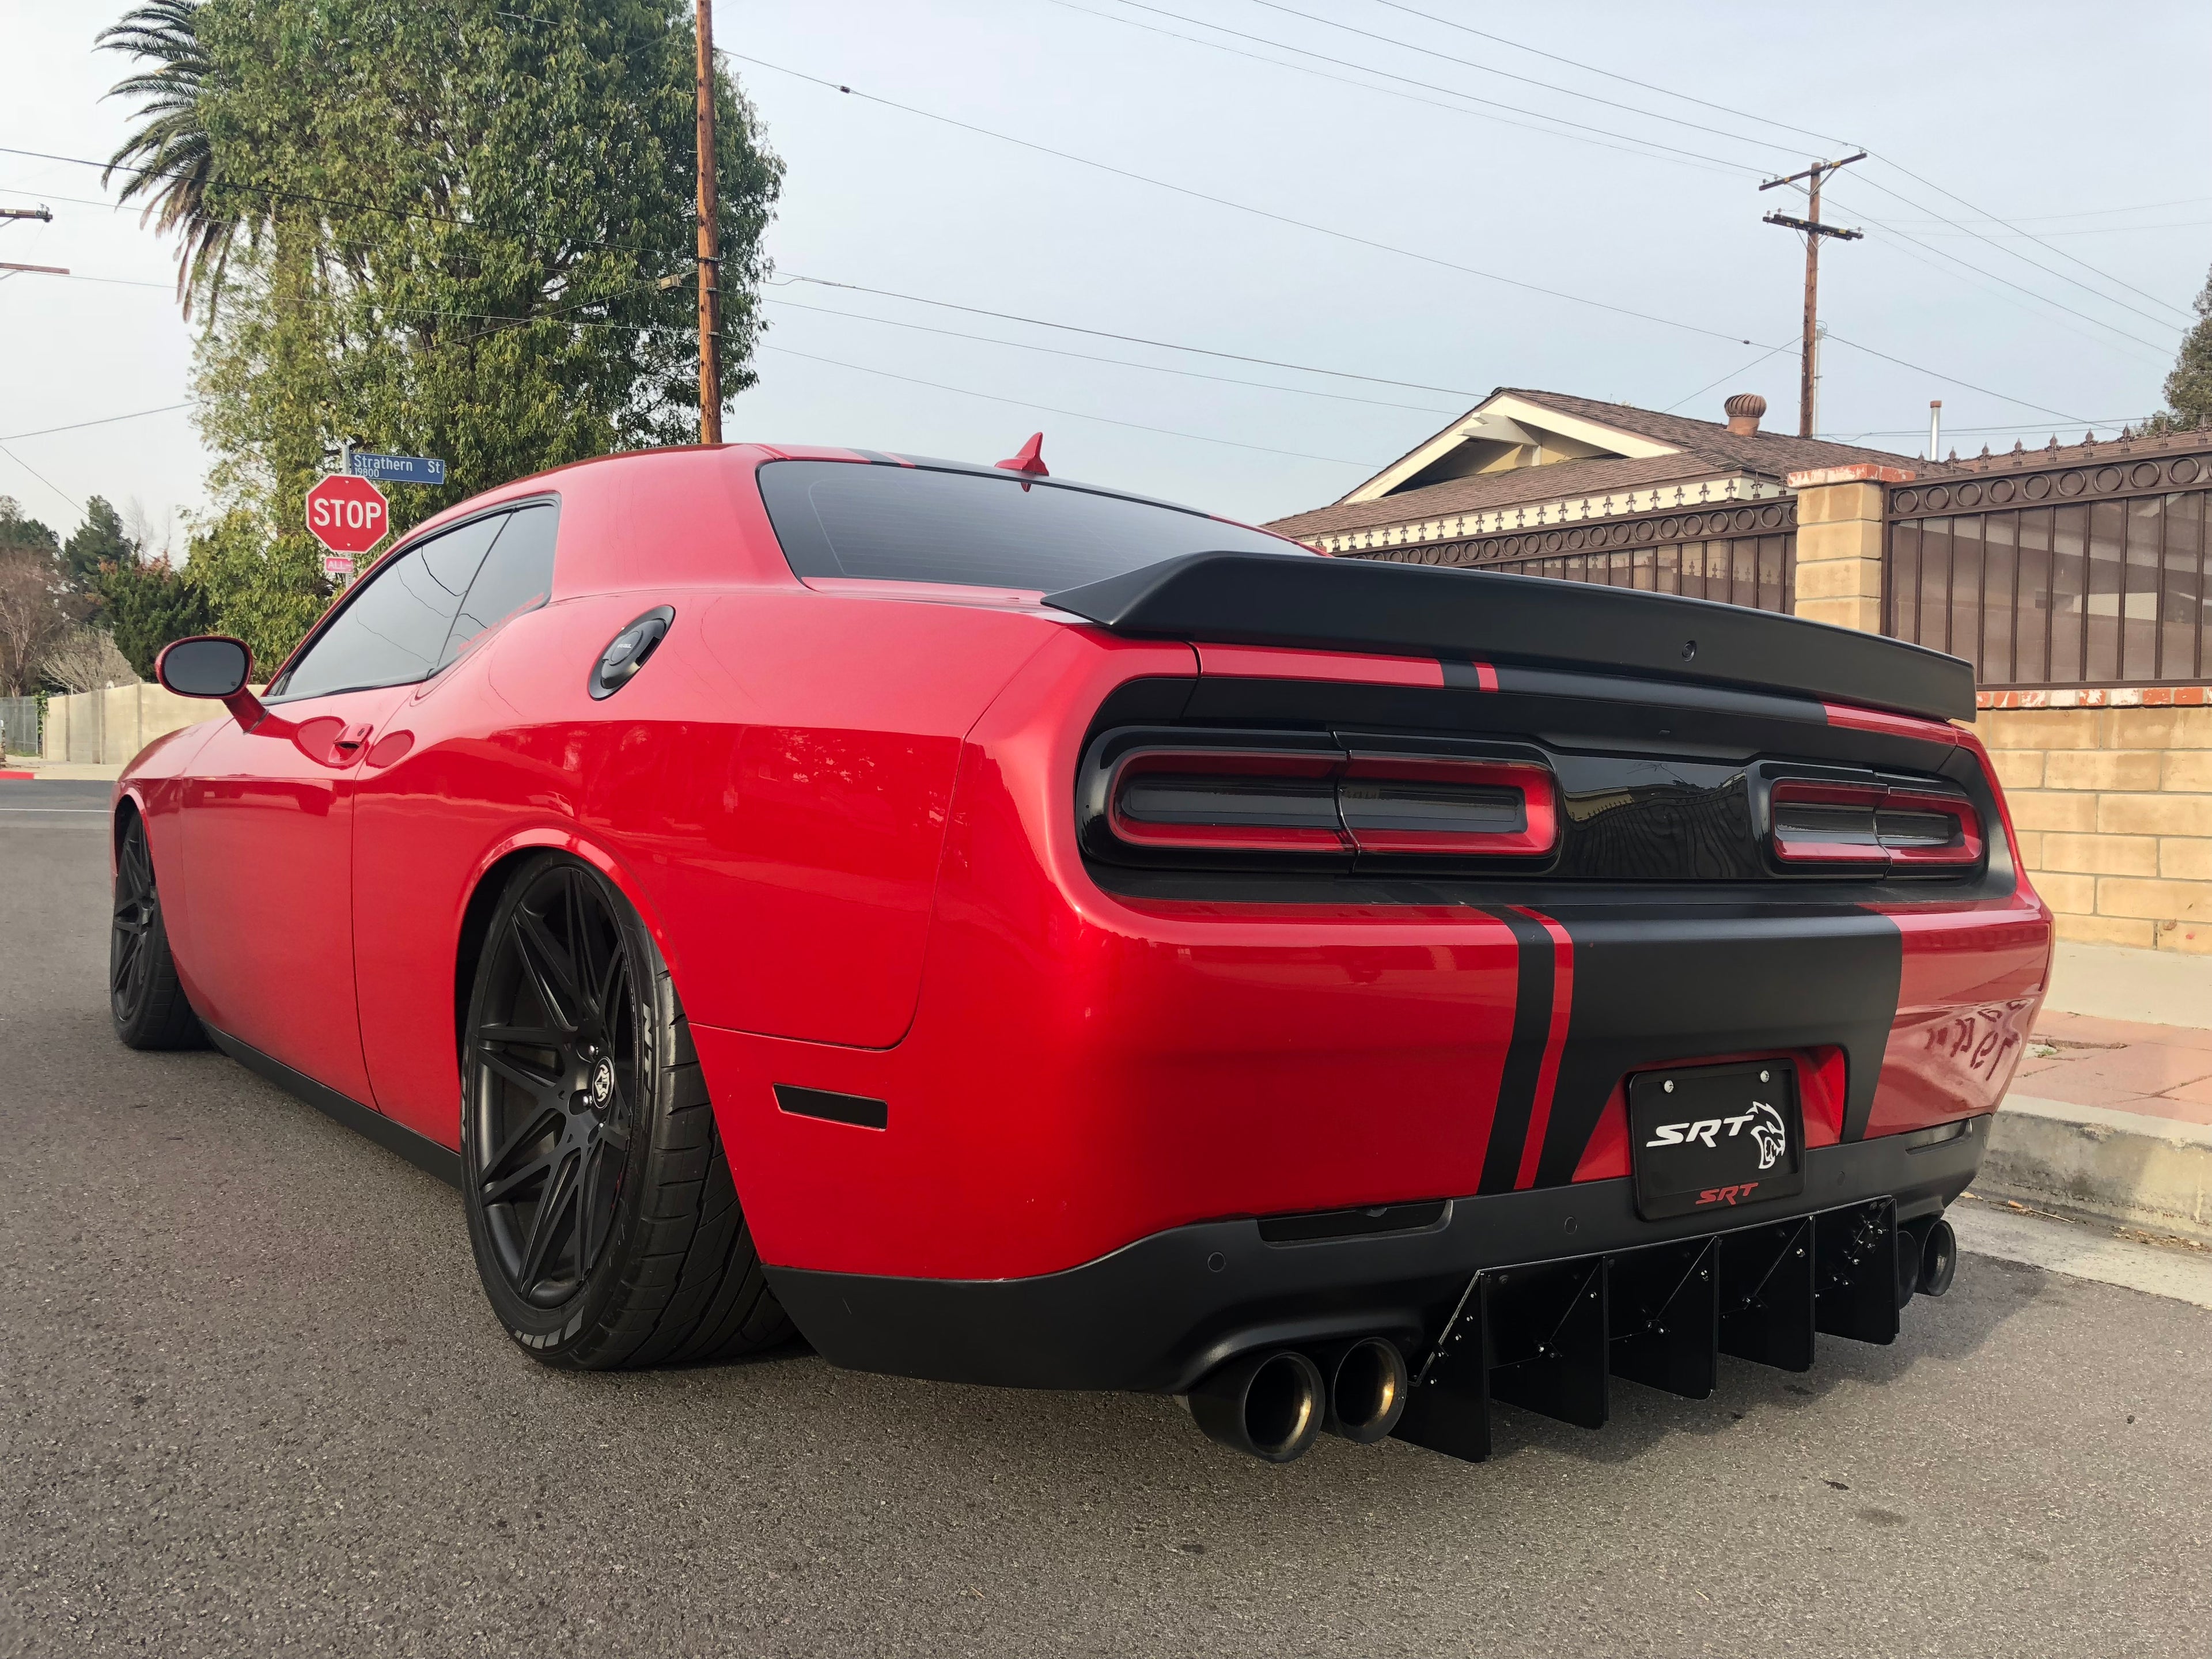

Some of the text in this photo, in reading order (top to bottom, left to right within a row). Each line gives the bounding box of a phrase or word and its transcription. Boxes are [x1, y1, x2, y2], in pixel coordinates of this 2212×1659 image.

[354, 454, 441, 474] Strathern St
[354, 467, 380, 478] 19800
[313, 498, 382, 529] STOP
[327, 560, 353, 570] ALL-
[1646, 1115, 1755, 1147] SRT
[1695, 1182, 1759, 1205] SRT
